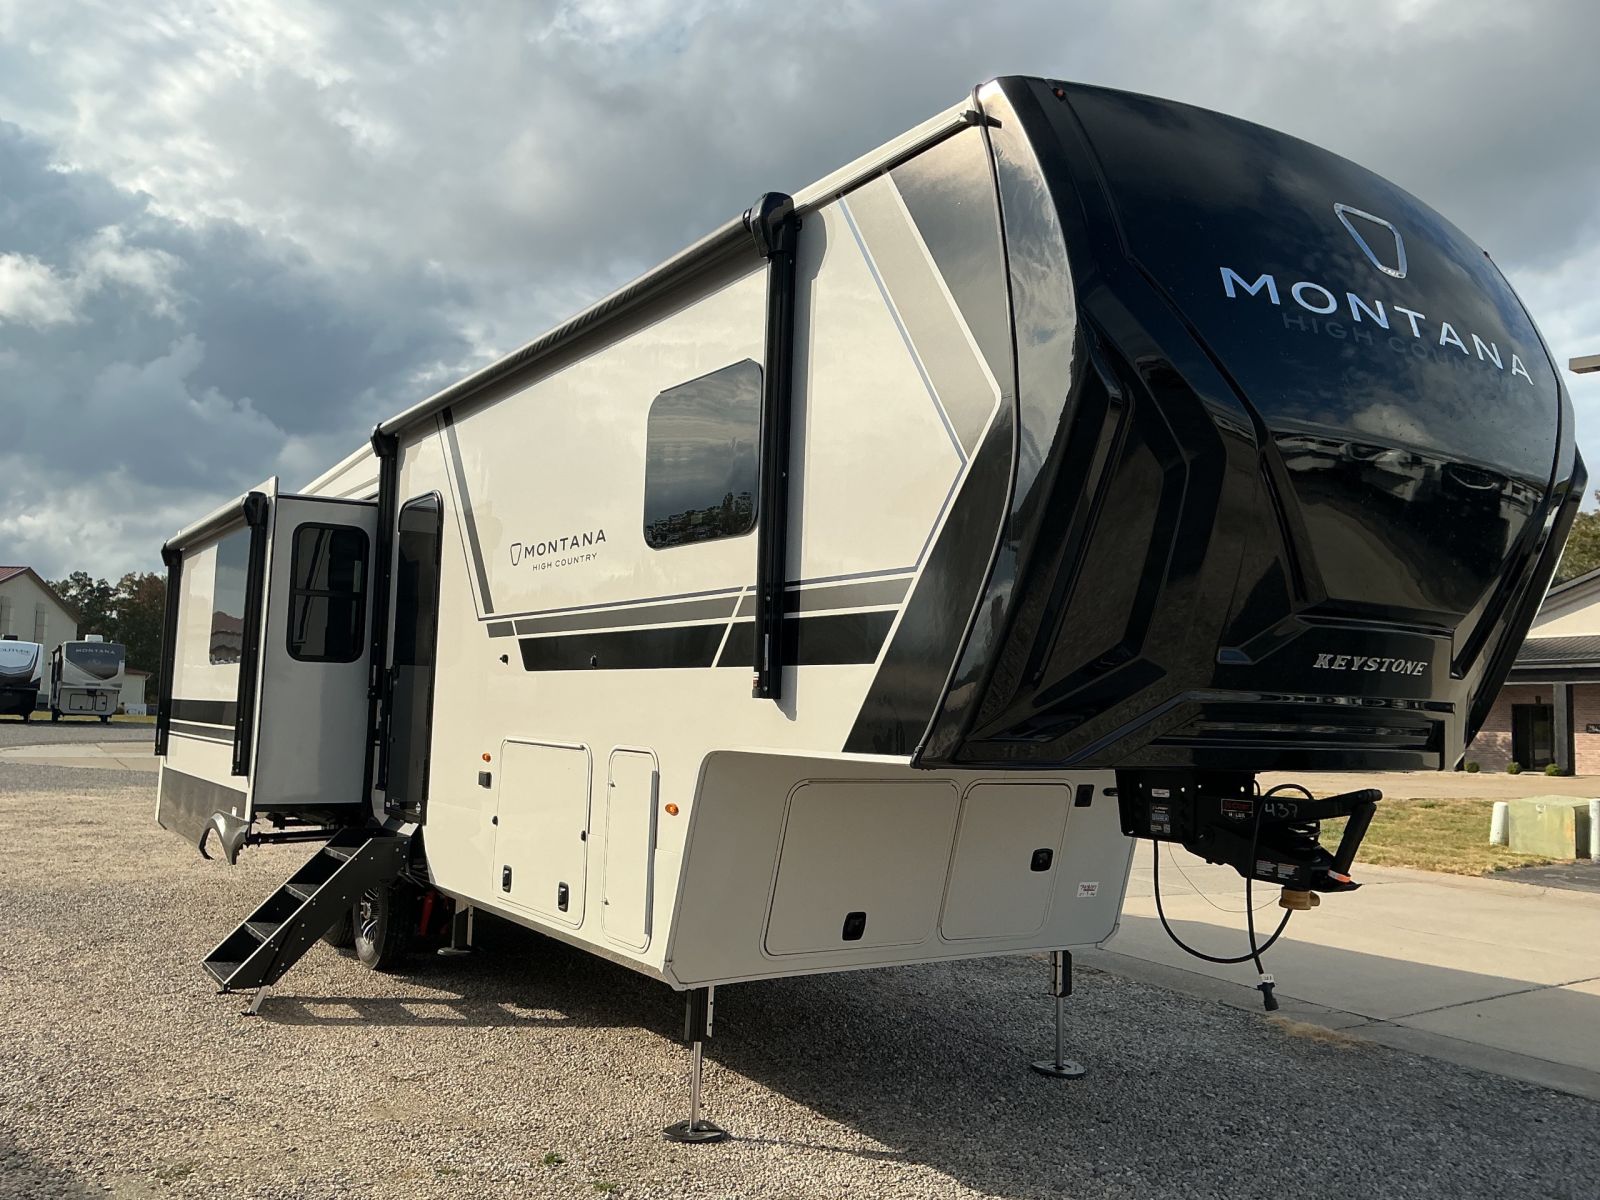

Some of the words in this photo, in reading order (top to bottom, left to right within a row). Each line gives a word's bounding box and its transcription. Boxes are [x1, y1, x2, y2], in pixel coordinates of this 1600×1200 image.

[1219, 266, 1535, 386] MONTANA
[1282, 311, 1374, 346] HIGH
[524, 529, 606, 559] MONTANA
[532, 561, 553, 572] HIGH
[554, 552, 598, 568] COUNTRY
[1312, 653, 1428, 676] KEYSTONE
[1264, 802, 1298, 819] 437
